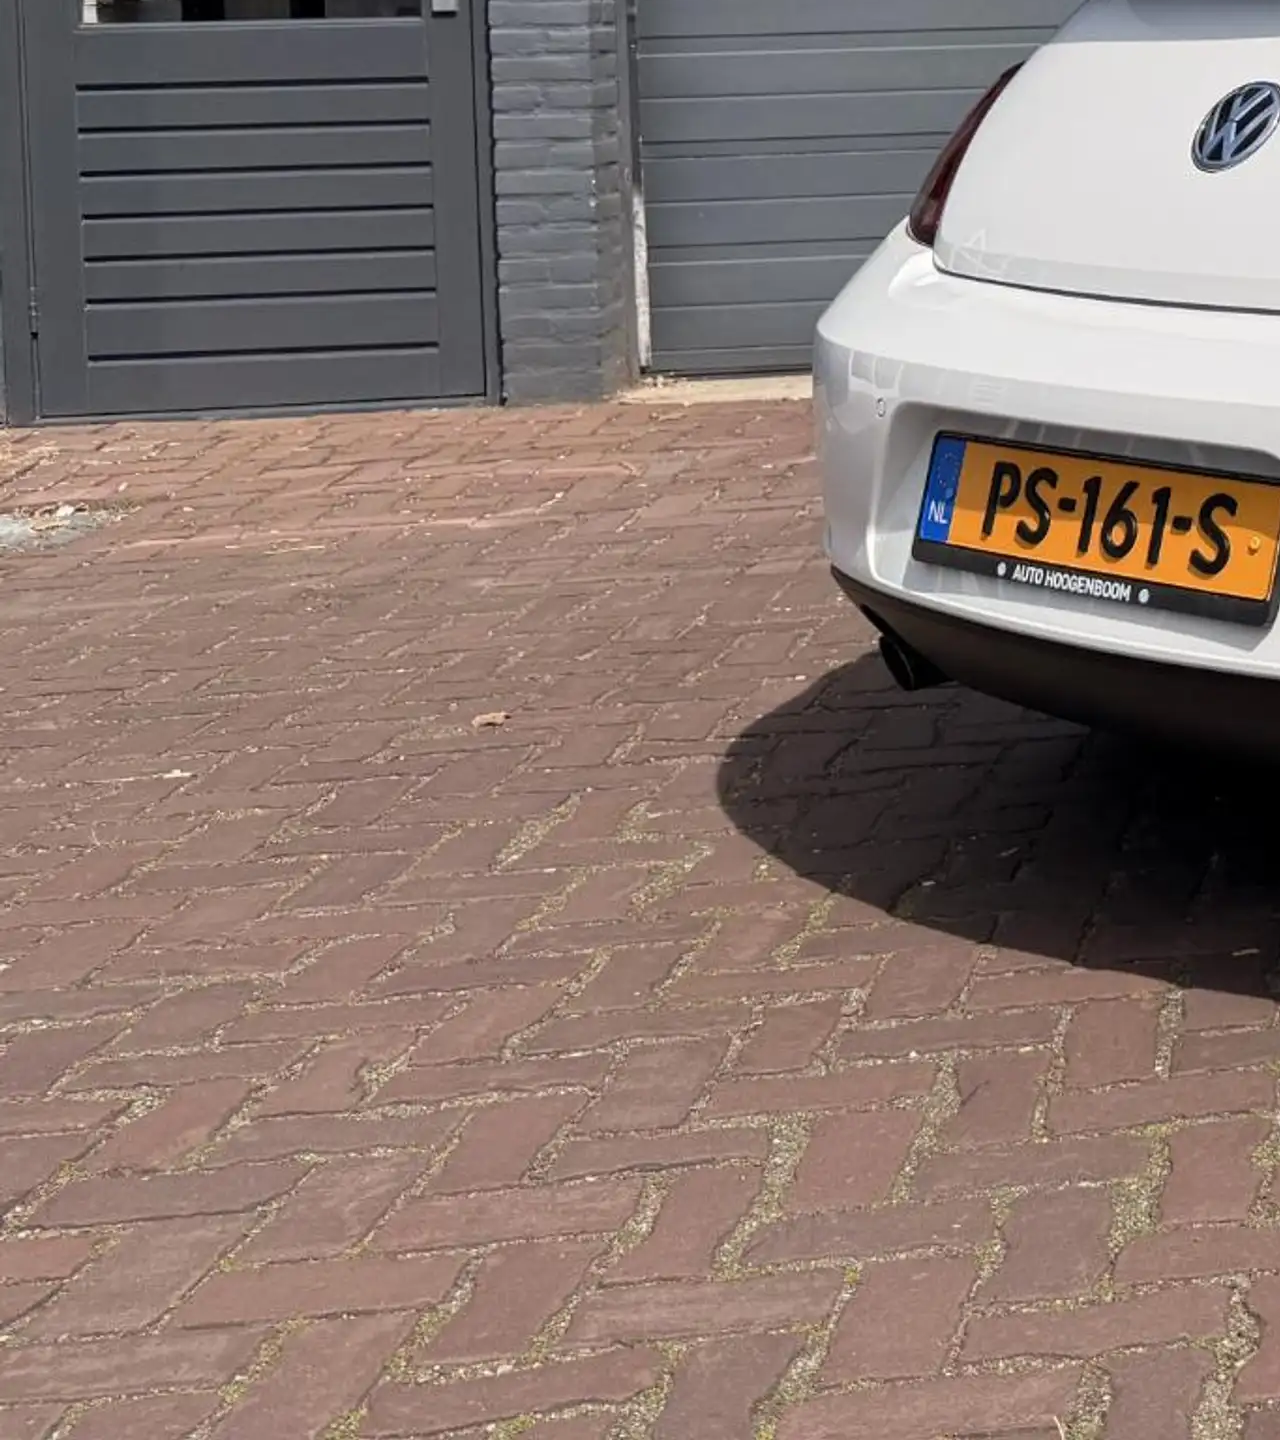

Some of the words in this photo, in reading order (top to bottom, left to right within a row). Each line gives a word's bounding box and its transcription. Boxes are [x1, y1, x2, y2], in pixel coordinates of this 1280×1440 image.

[927, 499, 948, 524] NL
[980, 461, 1238, 575] PS-161-S
[1012, 564, 1043, 584] AUTO
[1044, 570, 1131, 602] HOOGENBOOM
